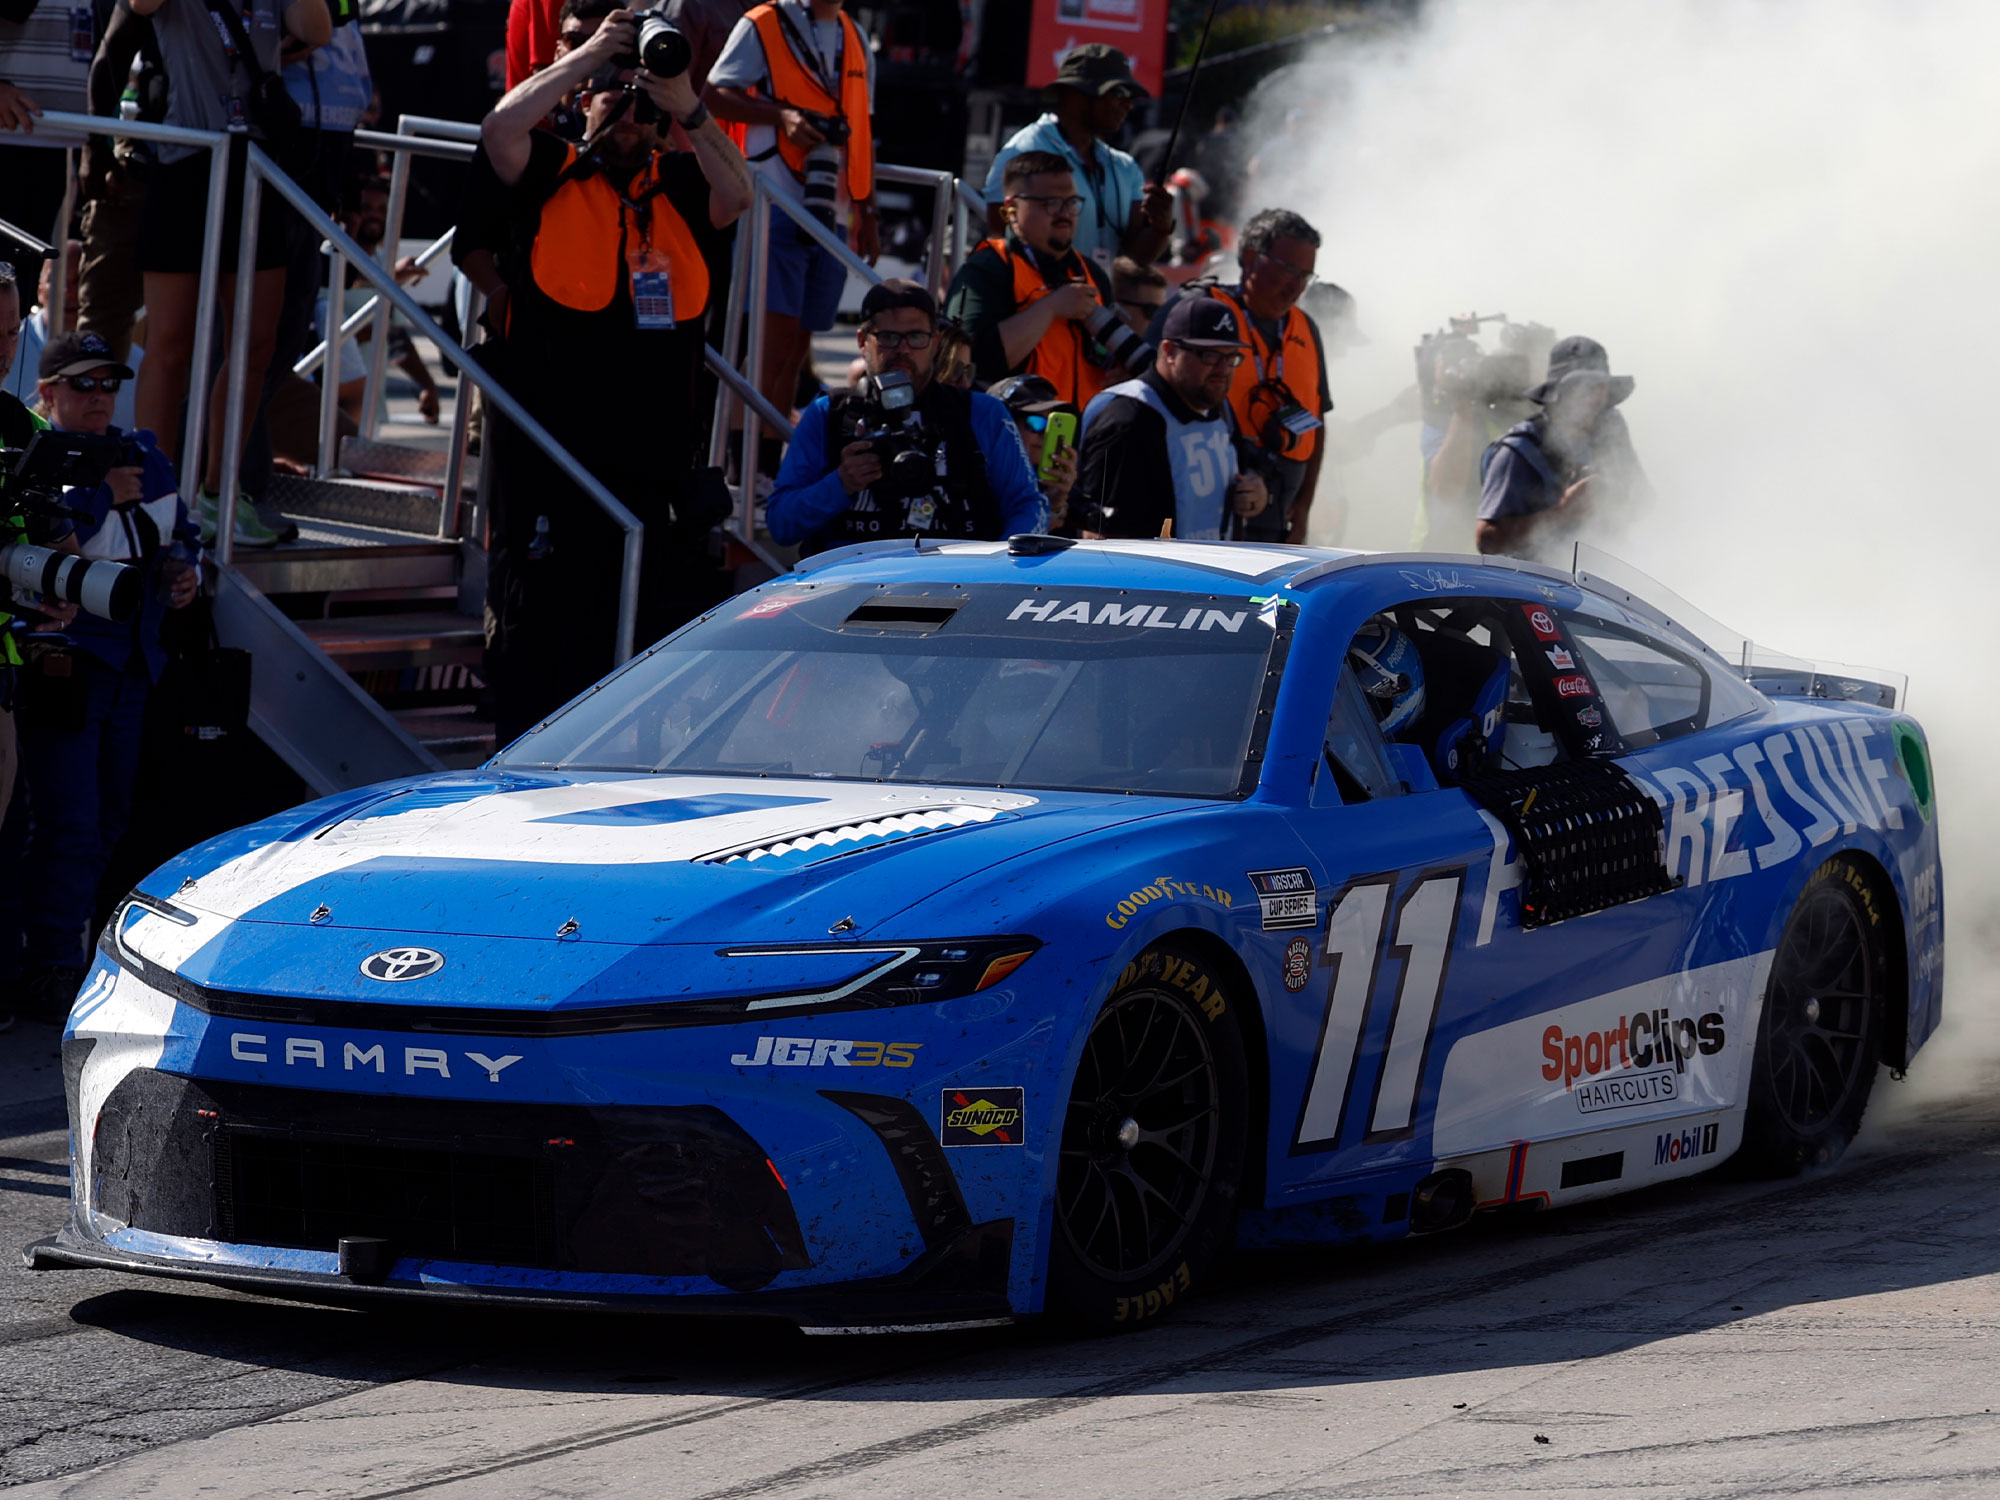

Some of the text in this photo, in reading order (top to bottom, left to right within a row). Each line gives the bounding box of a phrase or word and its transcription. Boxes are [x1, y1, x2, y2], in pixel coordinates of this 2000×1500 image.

[1006, 599, 1249, 633] HAMLIN
[1270, 872, 1305, 891] NASCAR
[1268, 896, 1309, 917] CUP SERIES
[1293, 871, 1464, 1150] 11
[231, 1032, 524, 1082] CAMRY
[1578, 1074, 1674, 1109] HAIRCUTS
[949, 1108, 1018, 1127] SUNOCO
[1654, 1126, 1701, 1167] Mobil
[1113, 1260, 1191, 1321] EAGLE
